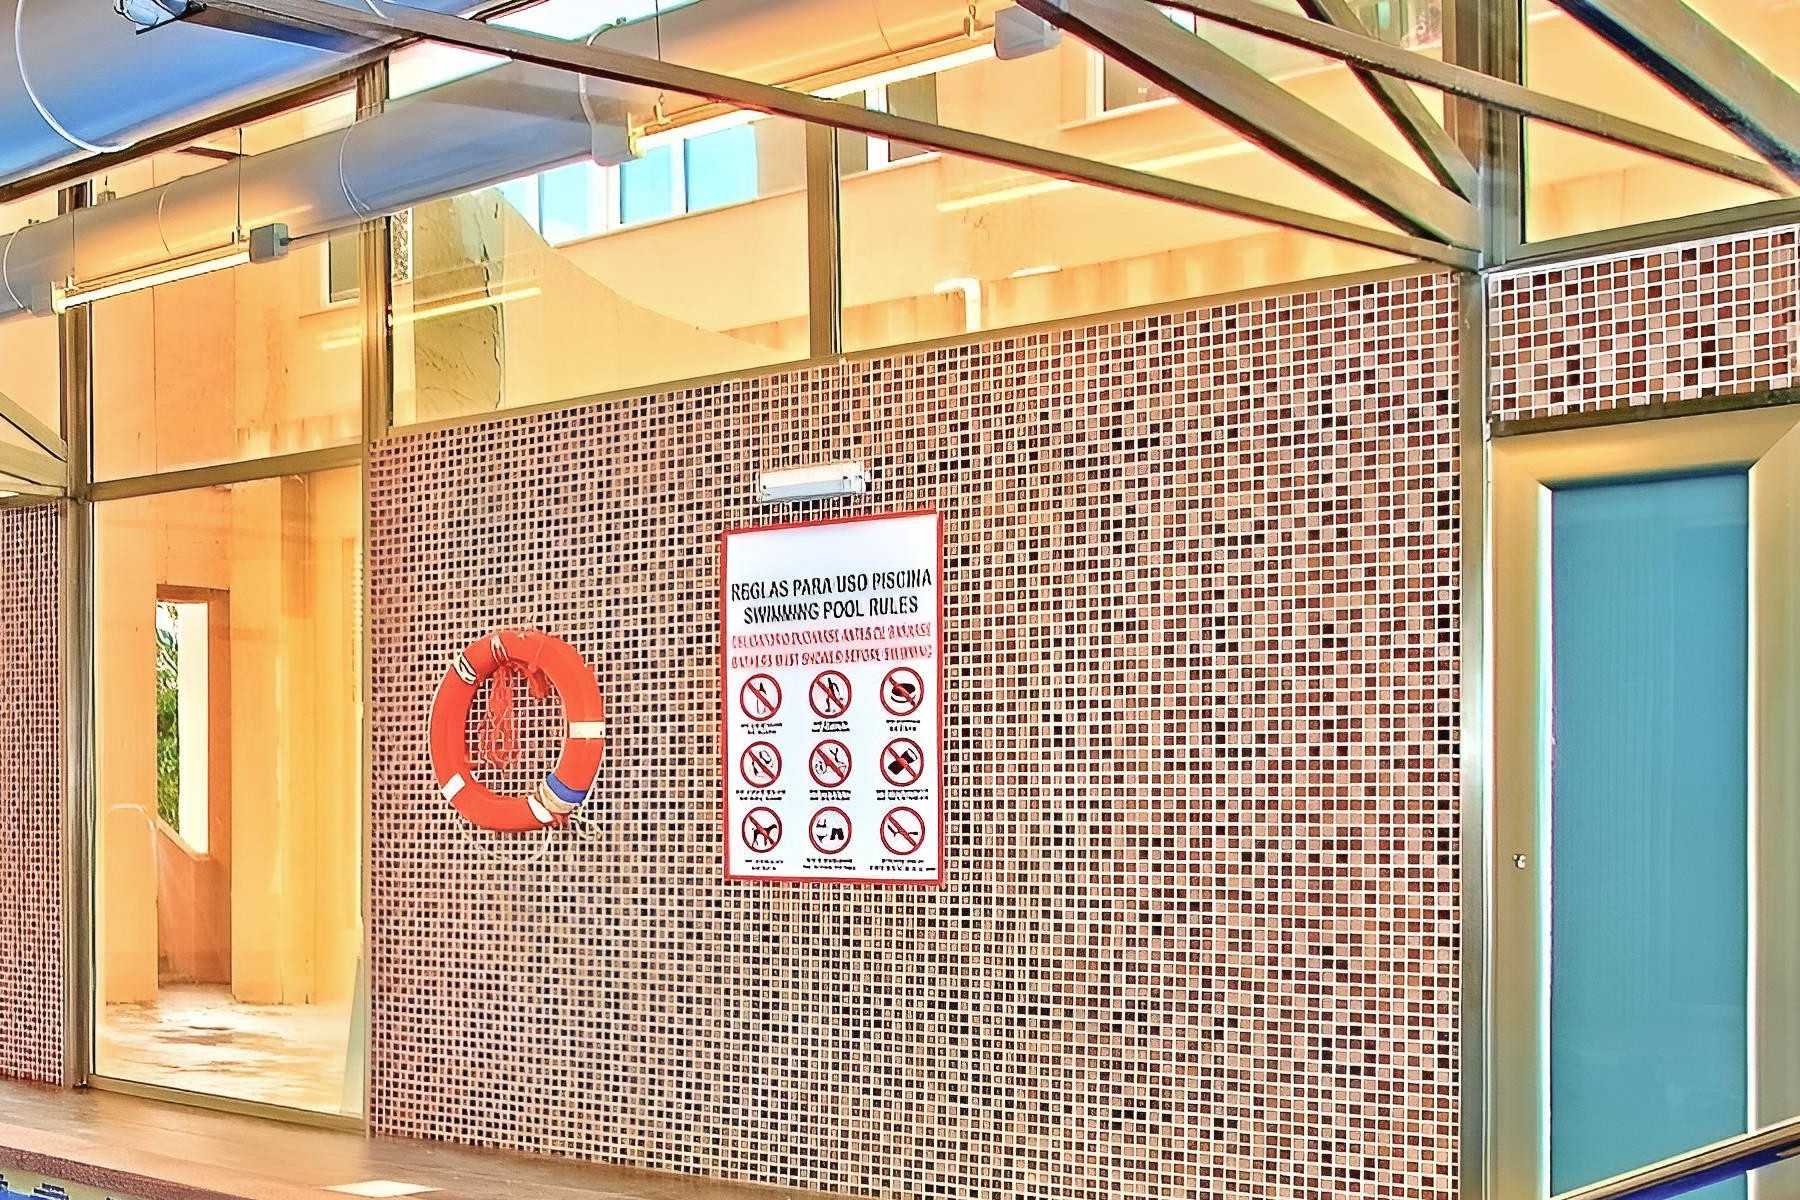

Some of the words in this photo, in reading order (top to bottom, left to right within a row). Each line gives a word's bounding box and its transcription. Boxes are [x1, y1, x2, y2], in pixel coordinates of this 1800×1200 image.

[731, 580, 789, 602] REGLAS
[793, 577, 832, 596] PARA
[836, 573, 868, 593] USO
[872, 568, 932, 590] PISCINA
[743, 602, 820, 624] SWIMMING
[823, 600, 864, 619] POOL
[869, 595, 918, 616] RULES
